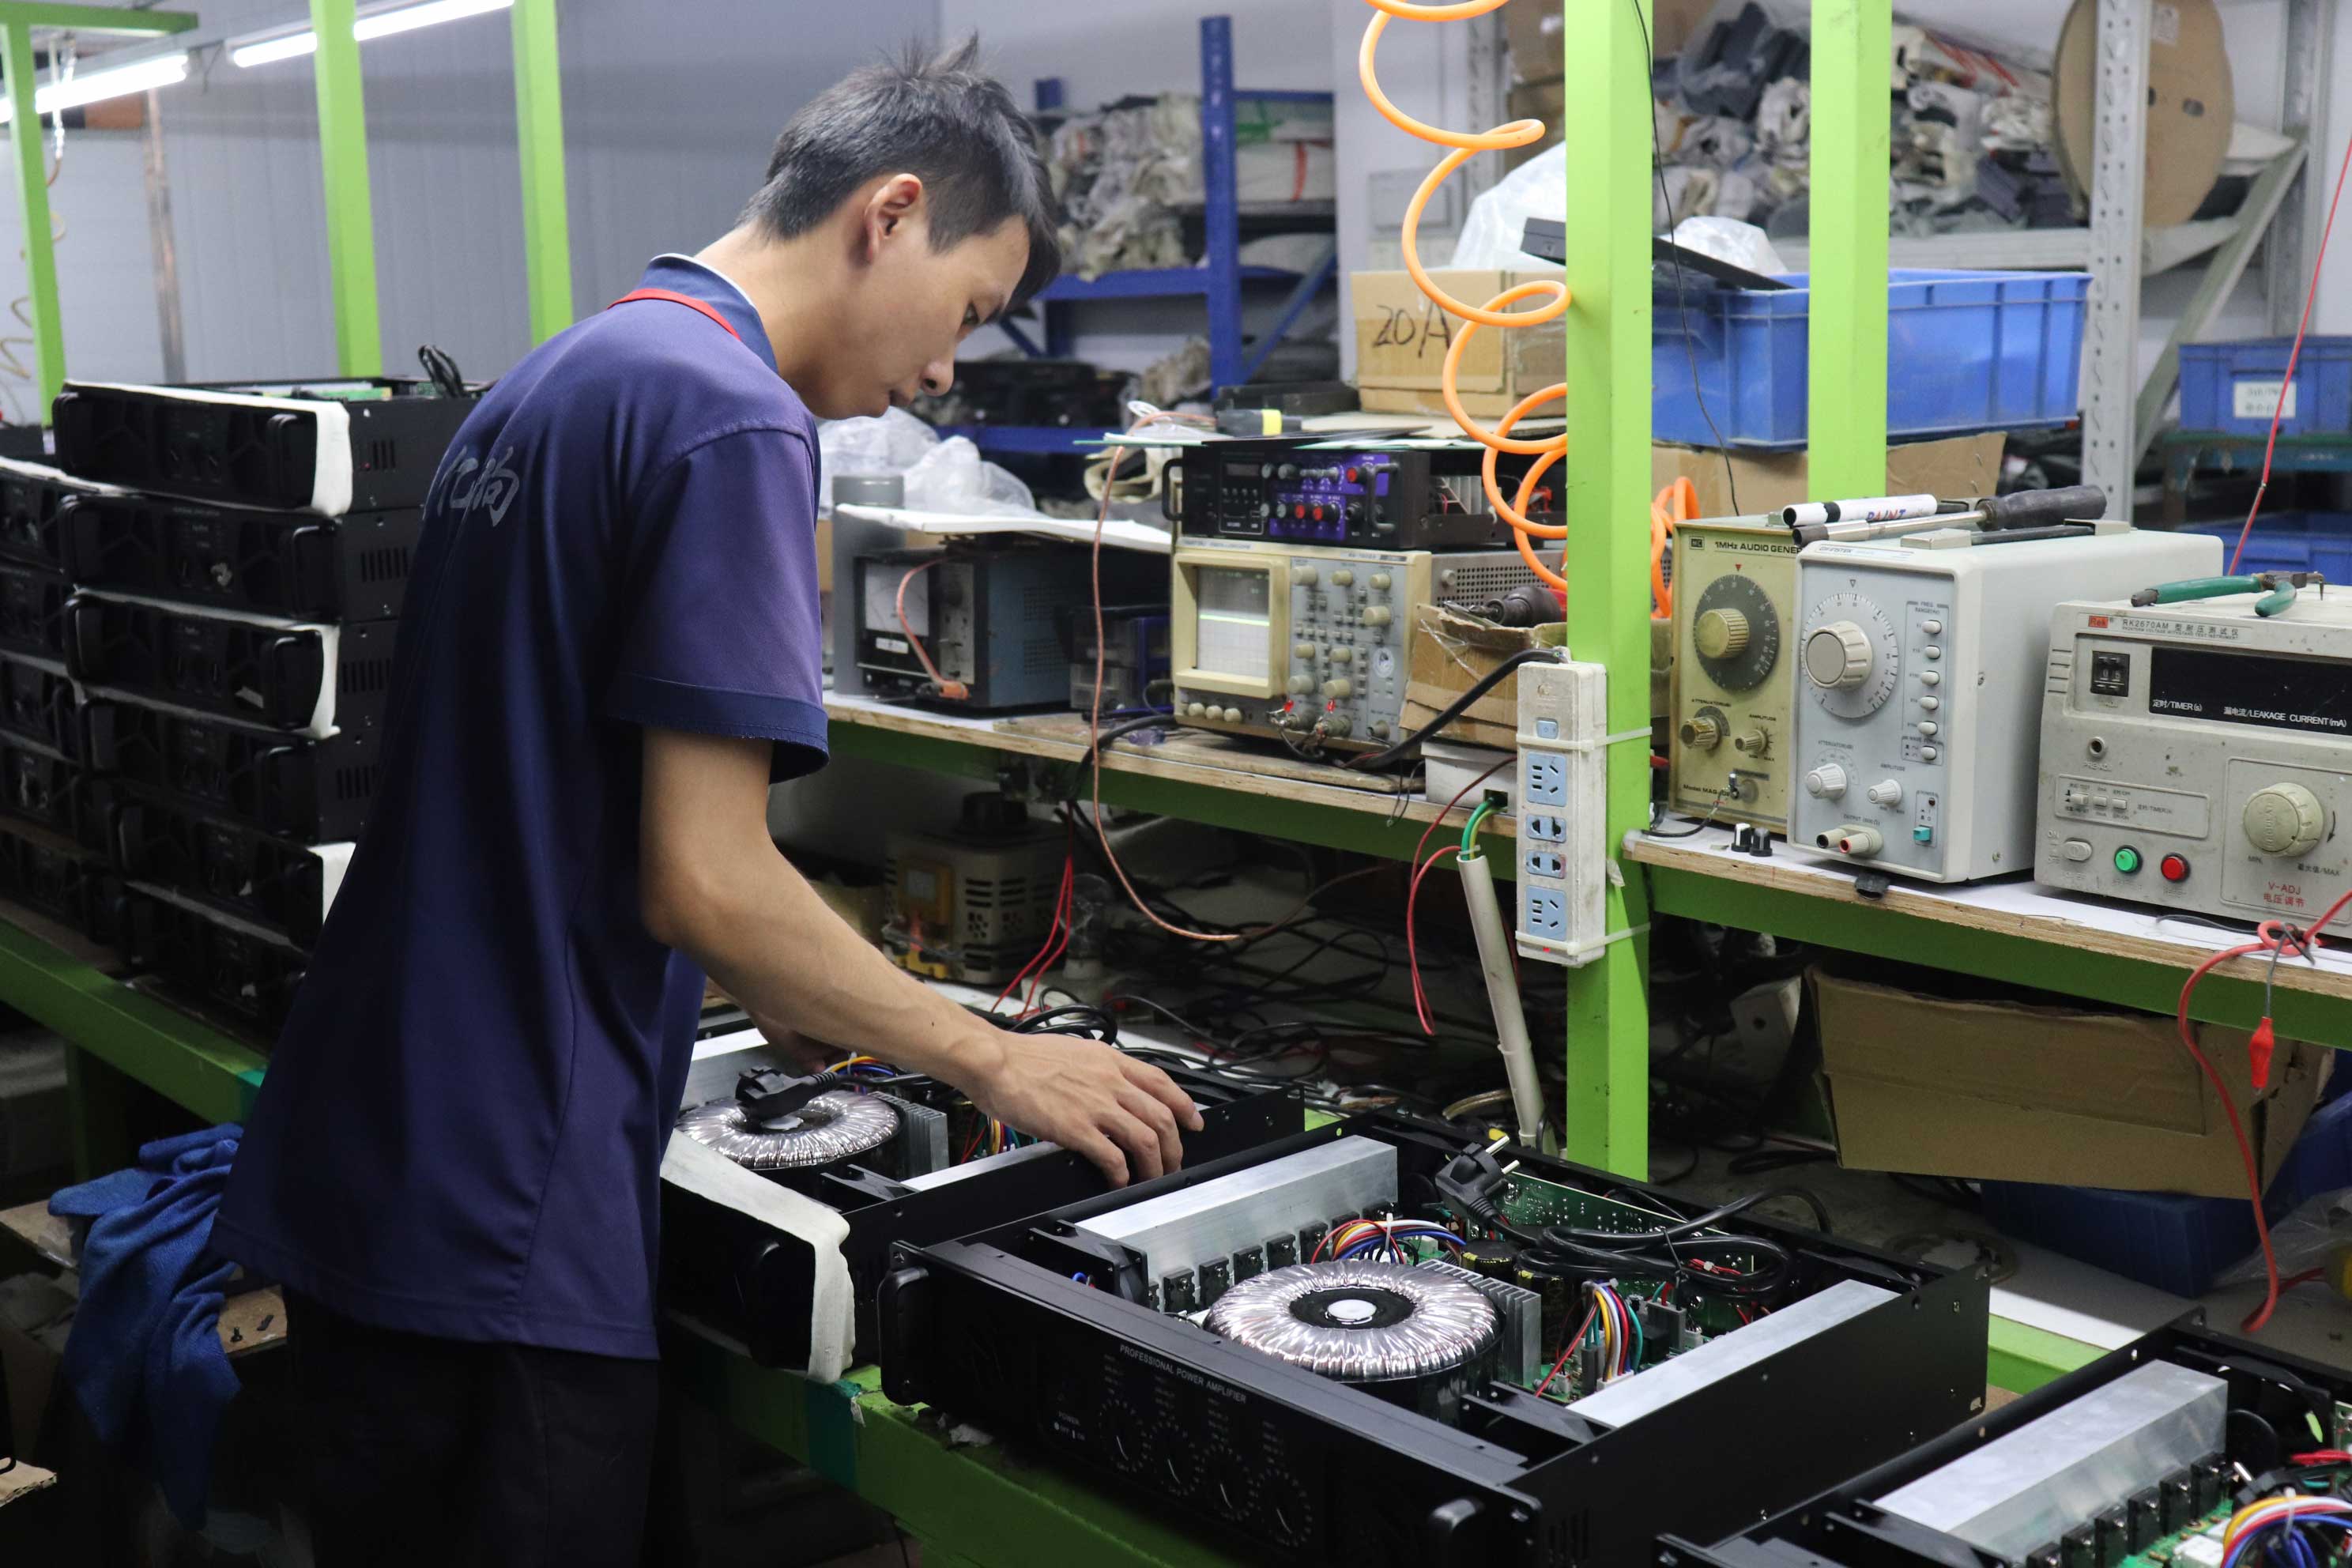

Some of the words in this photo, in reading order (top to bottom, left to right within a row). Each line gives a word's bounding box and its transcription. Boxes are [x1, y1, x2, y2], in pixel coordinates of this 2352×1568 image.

[1740, 543, 1769, 552] AUDIO
[2123, 619, 2169, 630] RK2670AM
[2268, 881, 2301, 895] V-ADJ
[1120, 1344, 1174, 1374] PROFESSIONAL
[1176, 1367, 1204, 1387] POWER
[1205, 1380, 1246, 1404] AMPLIFIER
